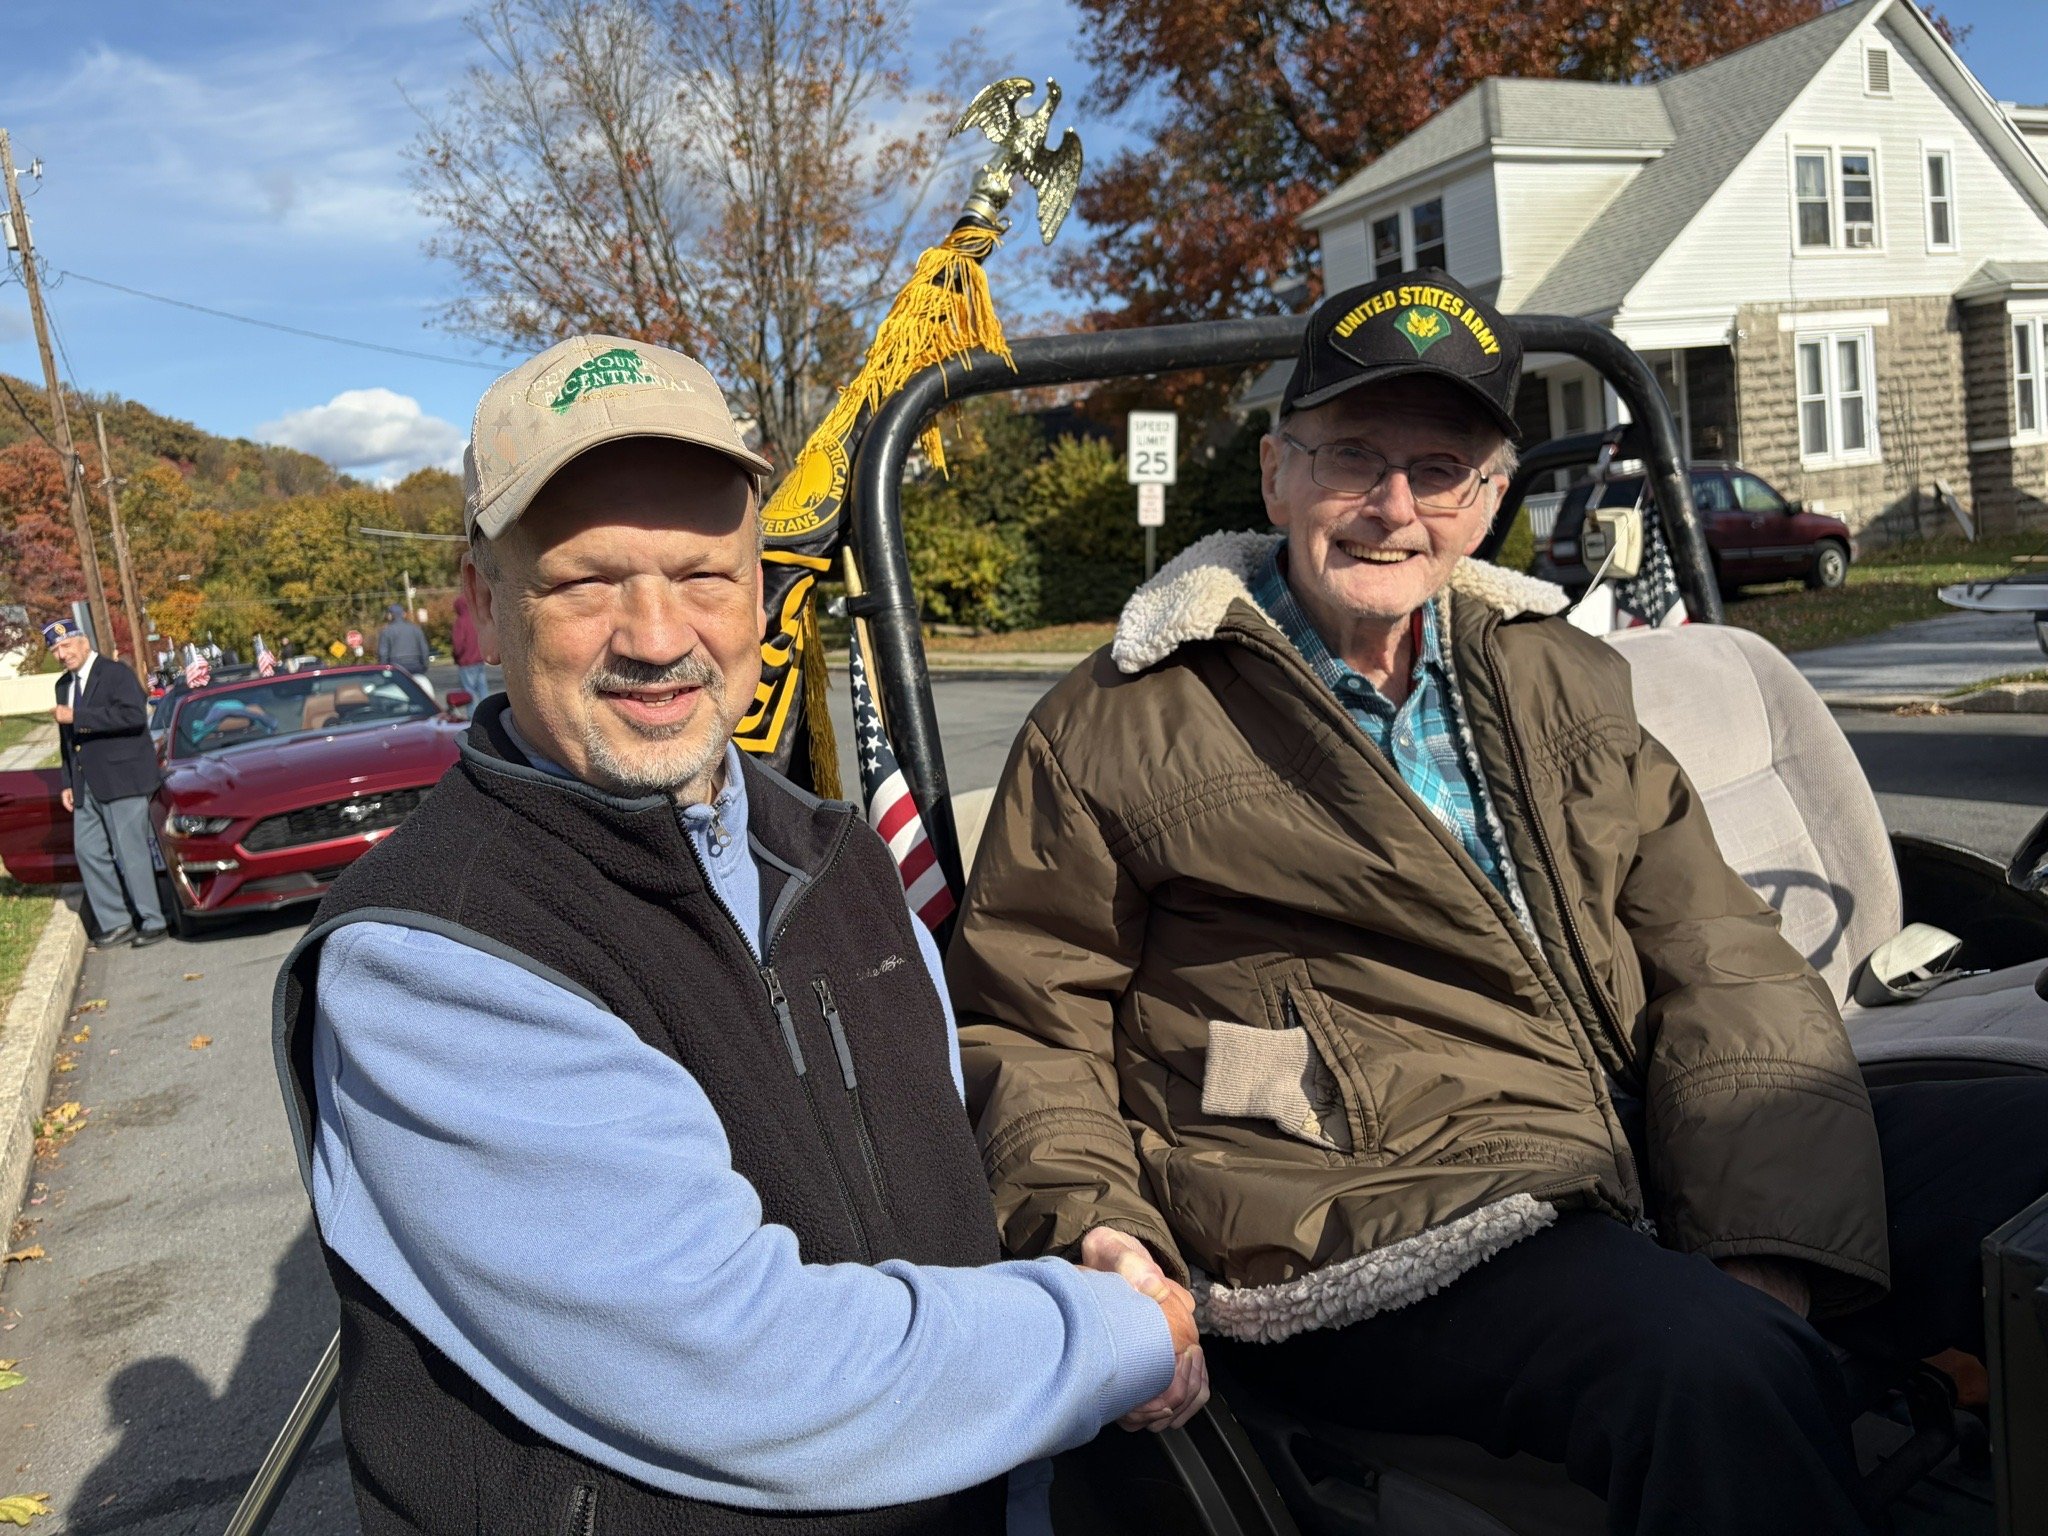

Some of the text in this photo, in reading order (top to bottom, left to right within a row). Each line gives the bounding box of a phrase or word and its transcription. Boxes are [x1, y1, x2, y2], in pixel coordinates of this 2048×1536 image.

[1334, 286, 1500, 355] UNITED STATES ARMY
[544, 369, 695, 406] BICENTENNIAL
[1136, 421, 1169, 432] SPEED
[1136, 436, 1166, 446] LIMIT
[824, 441, 847, 501] ERICAN
[1136, 451, 1168, 475] 25
